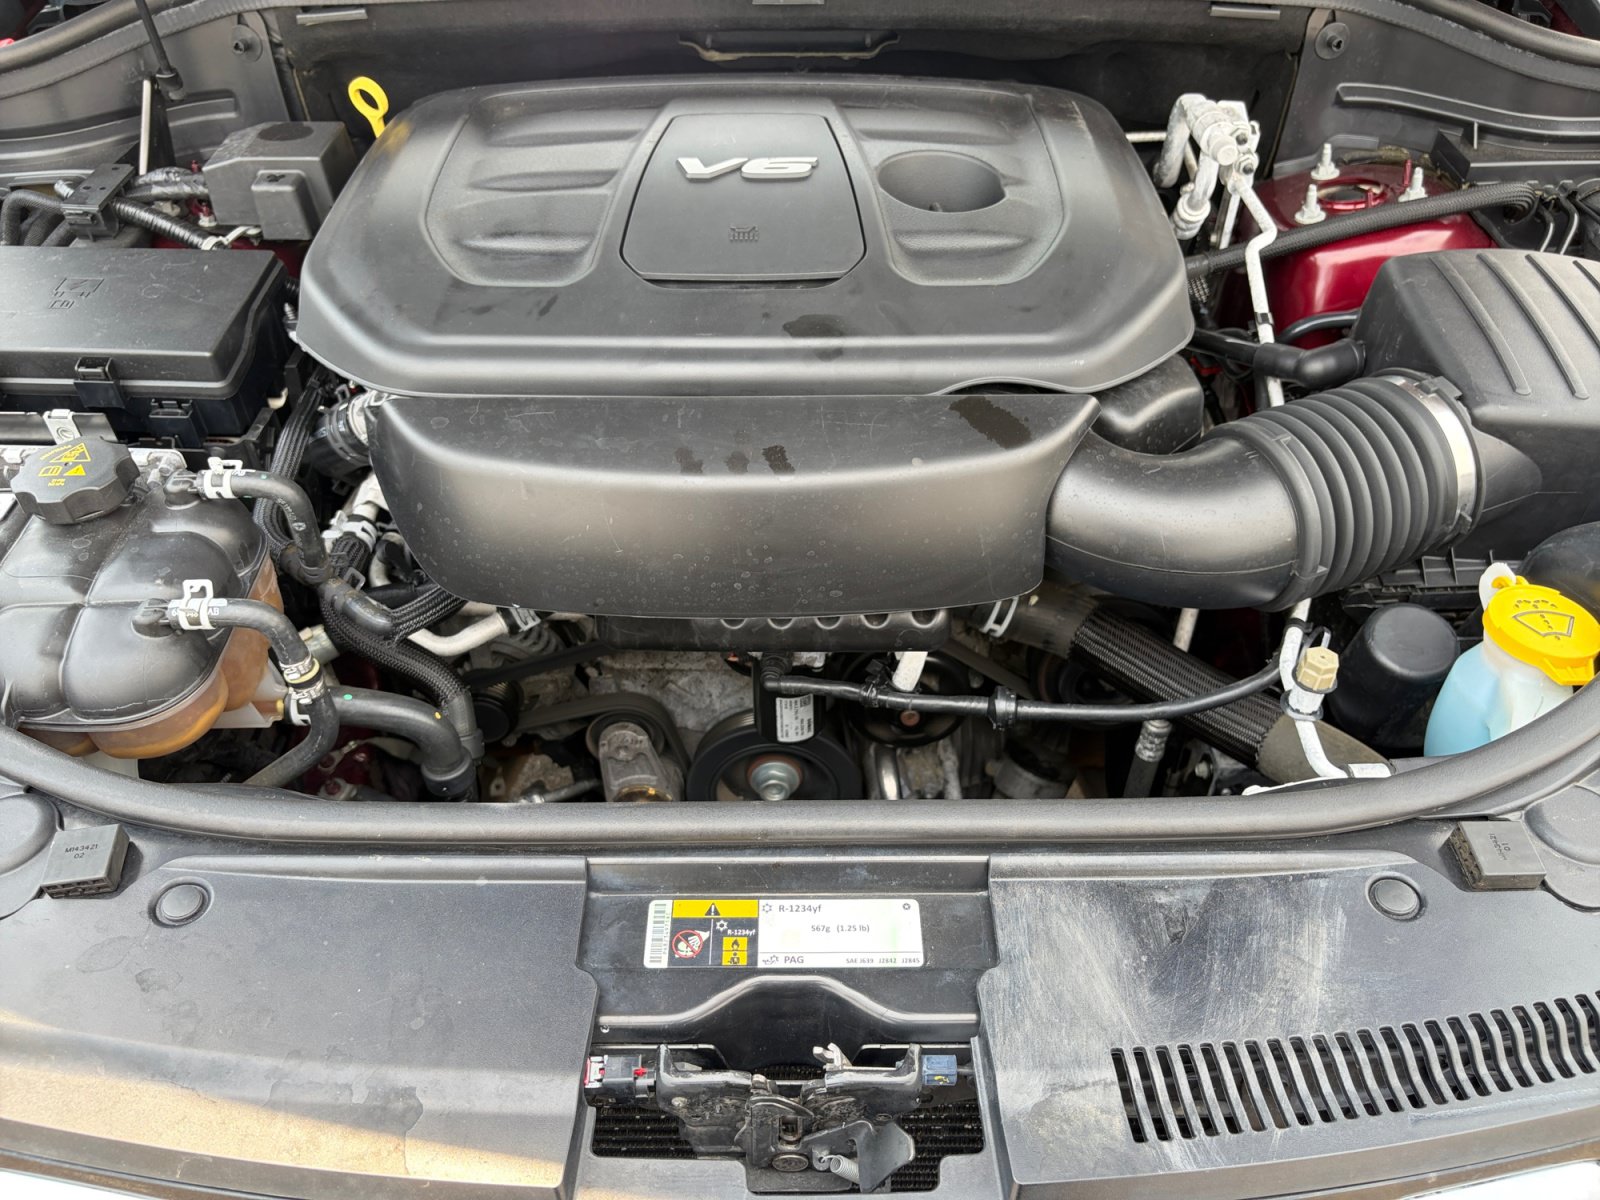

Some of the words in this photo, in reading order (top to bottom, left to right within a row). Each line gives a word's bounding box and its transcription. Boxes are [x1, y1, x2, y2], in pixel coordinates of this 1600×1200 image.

[676, 157, 818, 178] V6
[778, 904, 822, 914] R-1234yf
[811, 925, 831, 933] 567g
[836, 924, 857, 933] (1.25
[859, 924, 870, 933] lb)
[784, 955, 804, 964] PAG
